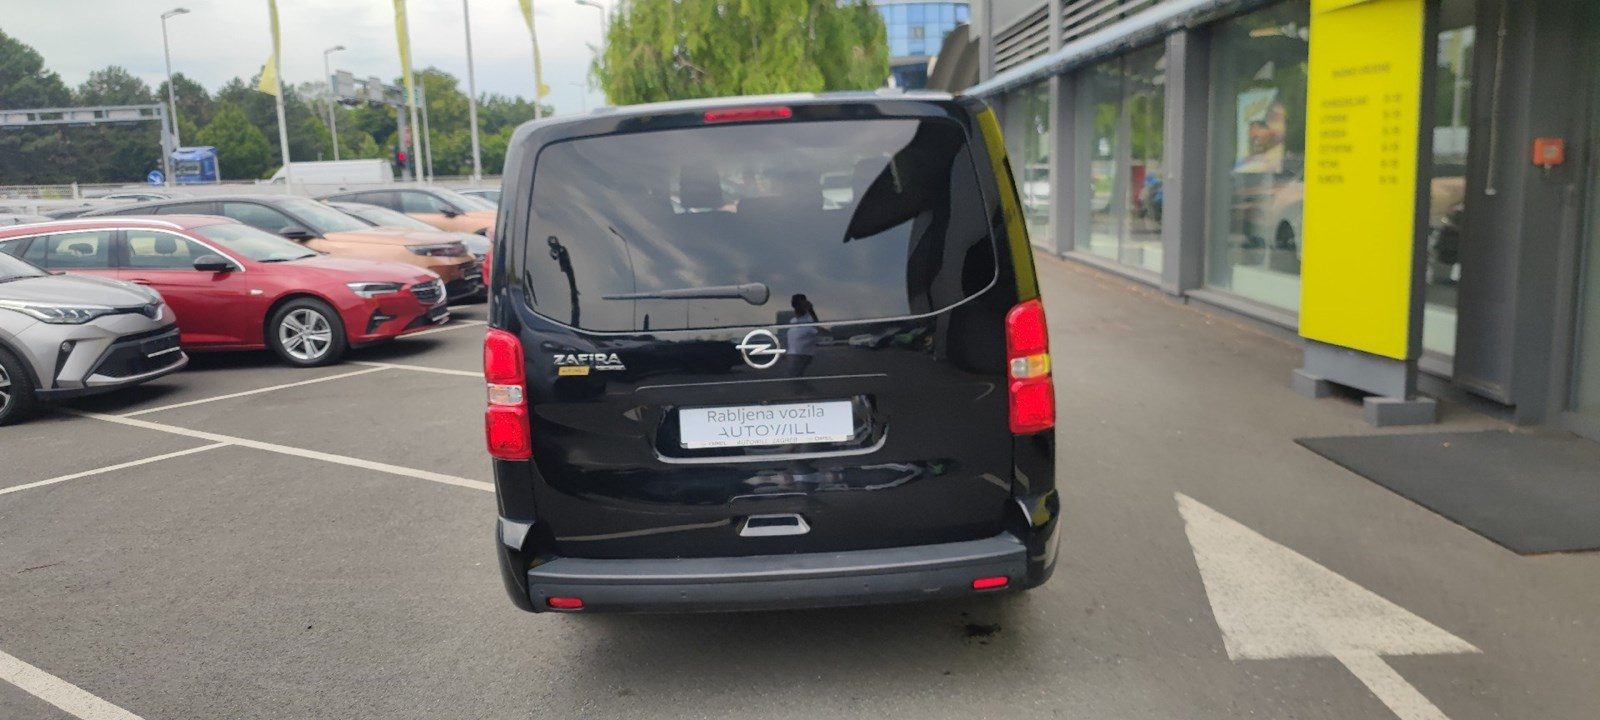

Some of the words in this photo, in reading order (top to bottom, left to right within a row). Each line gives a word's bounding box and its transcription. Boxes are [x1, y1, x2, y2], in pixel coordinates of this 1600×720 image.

[553, 353, 623, 366] ZAFIRA
[707, 408, 774, 425] Rabljena
[780, 404, 825, 419] vozila
